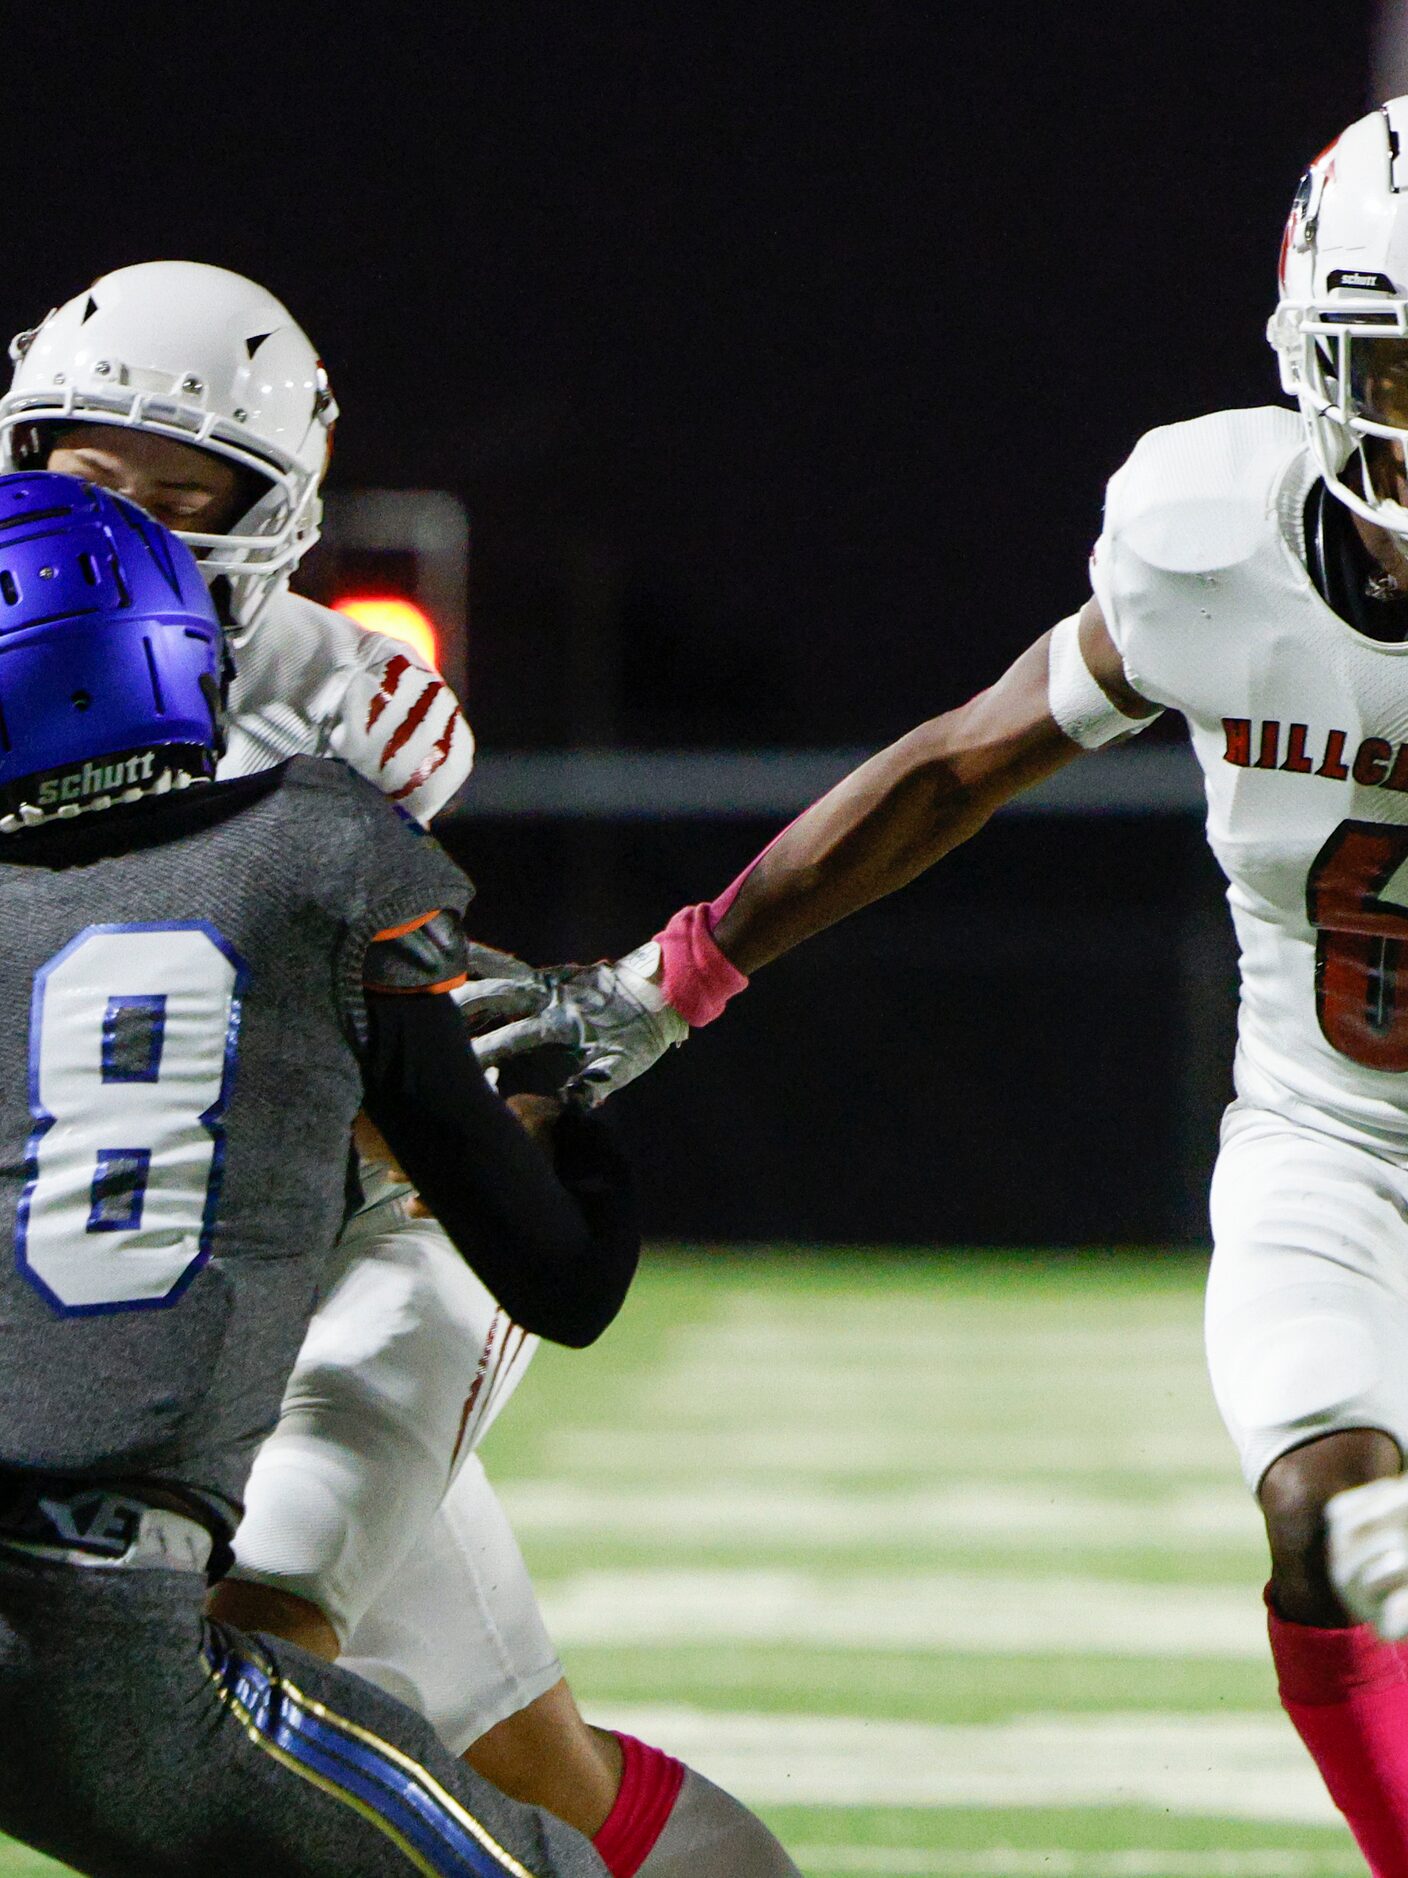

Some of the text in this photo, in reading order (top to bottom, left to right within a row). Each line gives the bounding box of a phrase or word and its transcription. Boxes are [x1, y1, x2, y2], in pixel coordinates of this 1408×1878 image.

[1340, 272, 1378, 286] schutt
[38, 751, 156, 805] schutt
[16, 918, 250, 1321] 8
